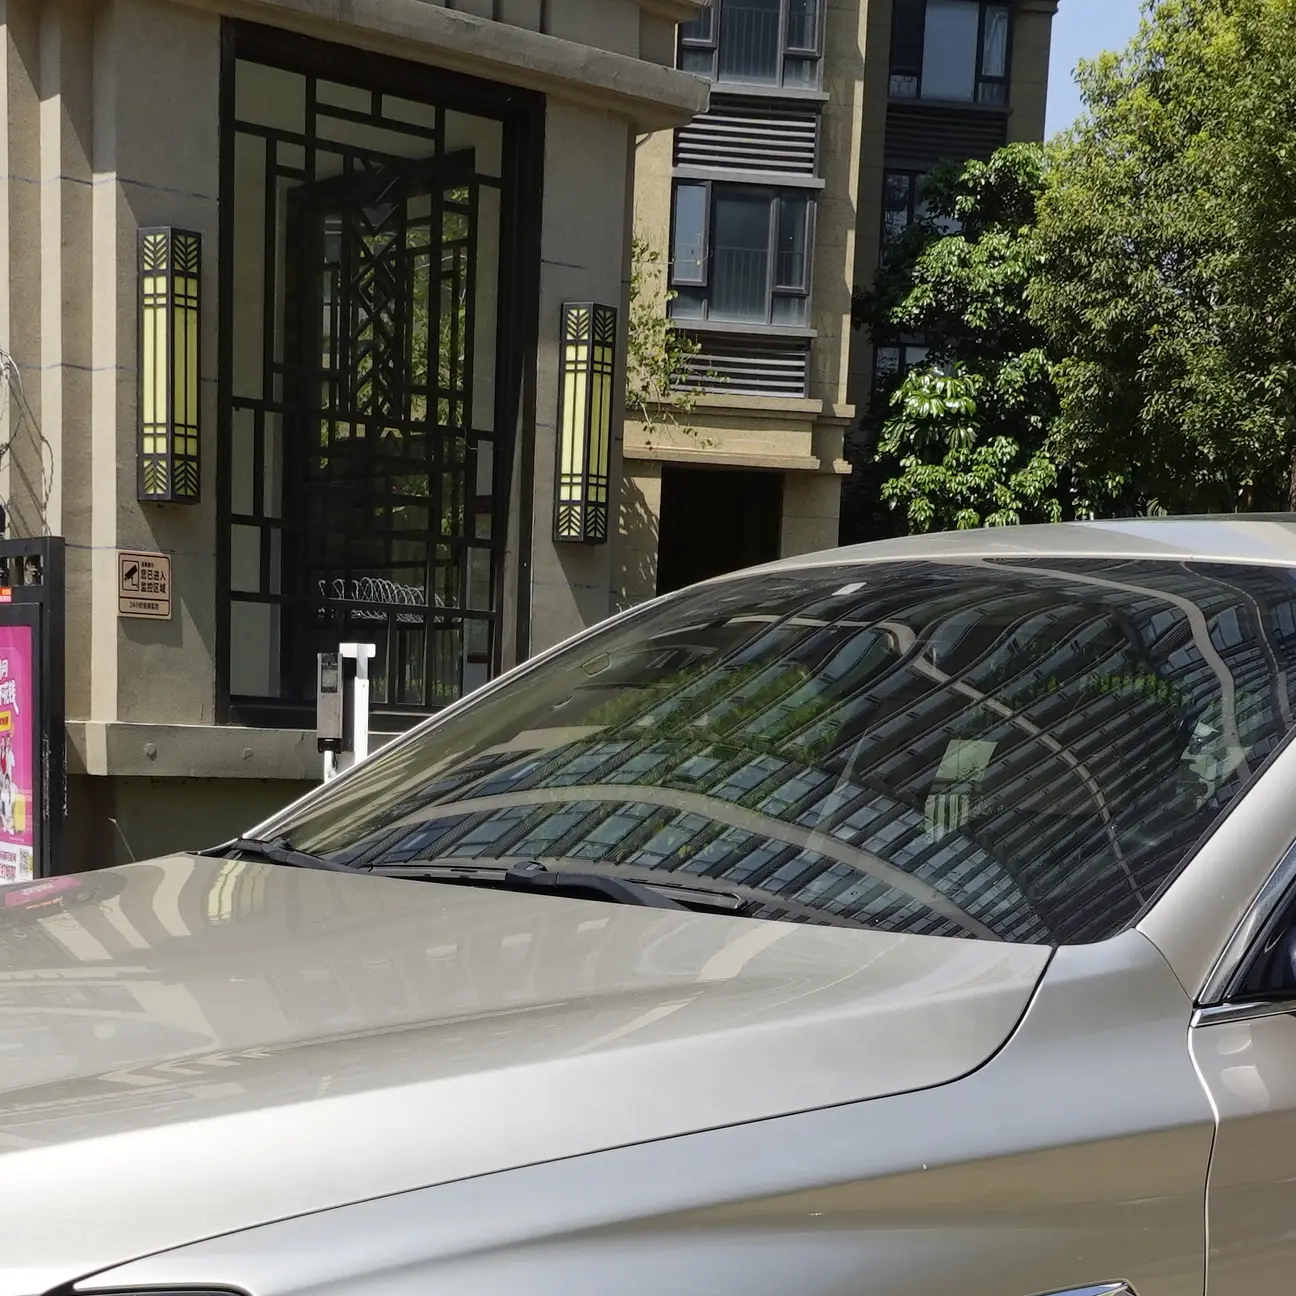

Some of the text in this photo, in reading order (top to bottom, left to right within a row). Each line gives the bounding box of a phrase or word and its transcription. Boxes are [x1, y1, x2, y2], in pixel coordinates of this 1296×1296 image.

[141, 569, 166, 581] 您已进入
[141, 581, 166, 593] 监控区域
